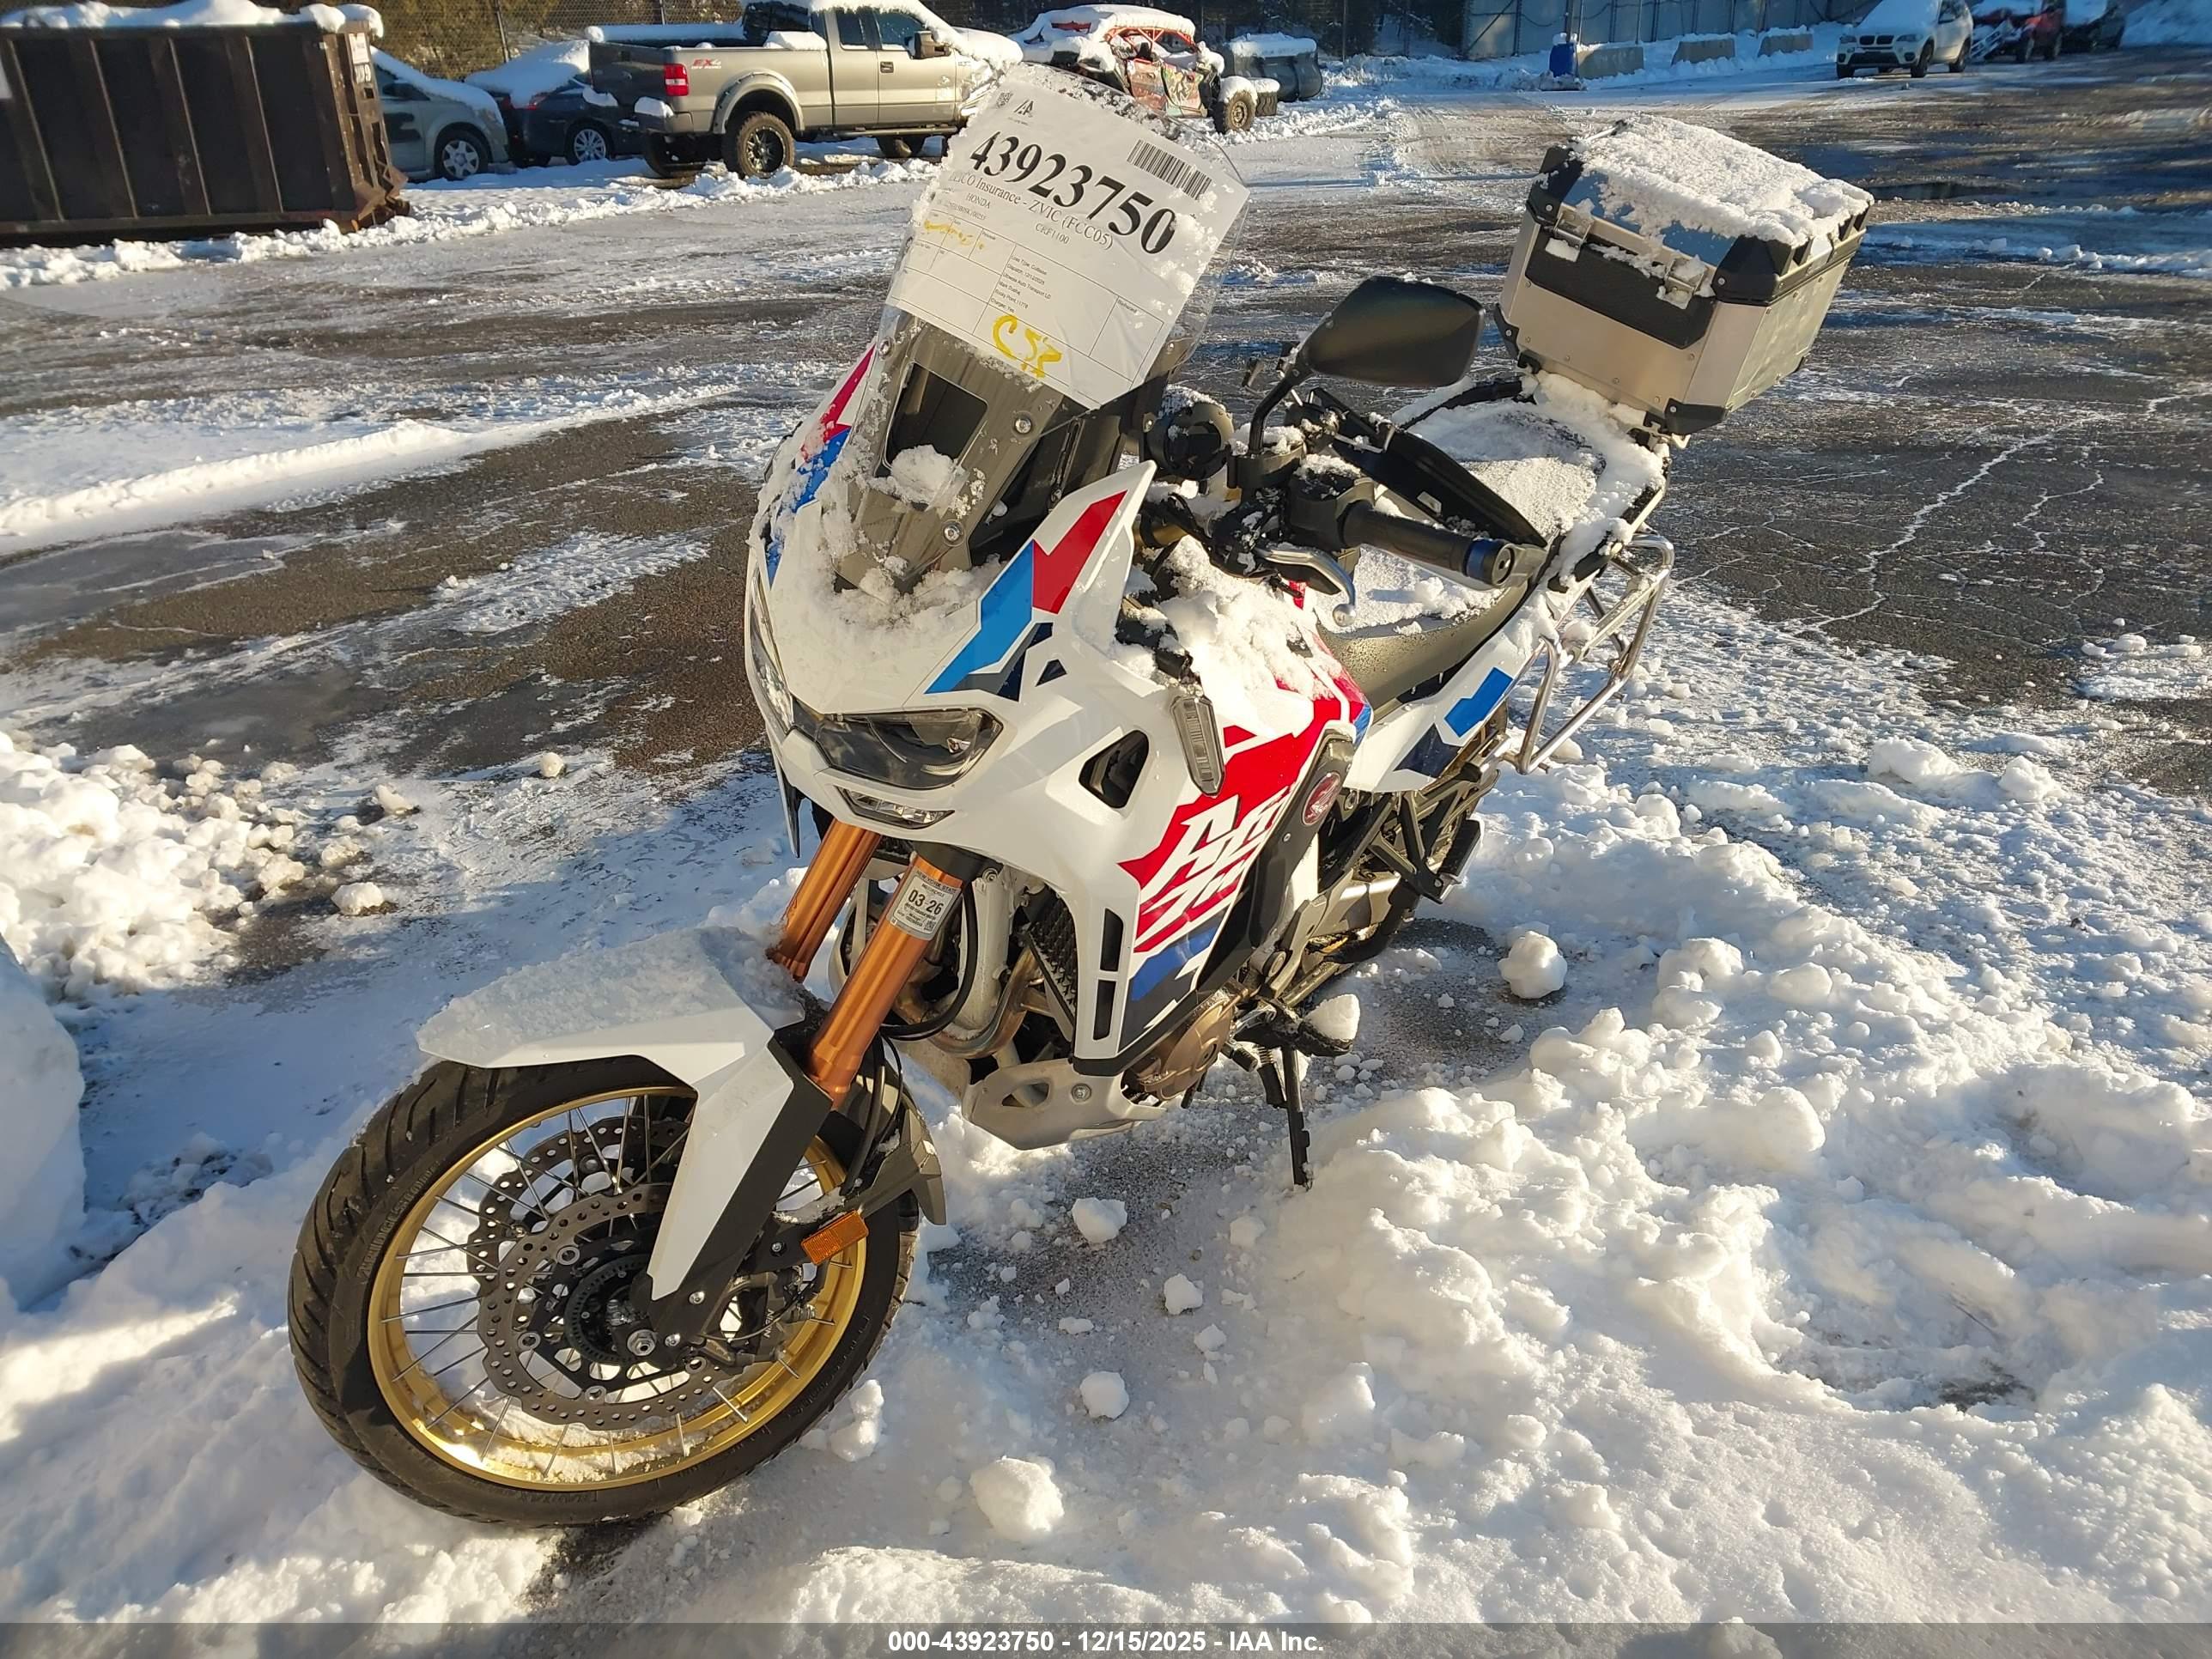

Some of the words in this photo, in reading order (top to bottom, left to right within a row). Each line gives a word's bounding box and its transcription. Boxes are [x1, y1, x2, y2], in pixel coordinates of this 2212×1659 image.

[966, 193, 991, 209] HONDA
[970, 131, 1176, 253] 43923750
[975, 177, 1022, 205] Insurance
[1029, 200, 1062, 222] ZVIC
[1061, 216, 1114, 251] (FCC05)
[1036, 222, 1070, 246] CRF1100
